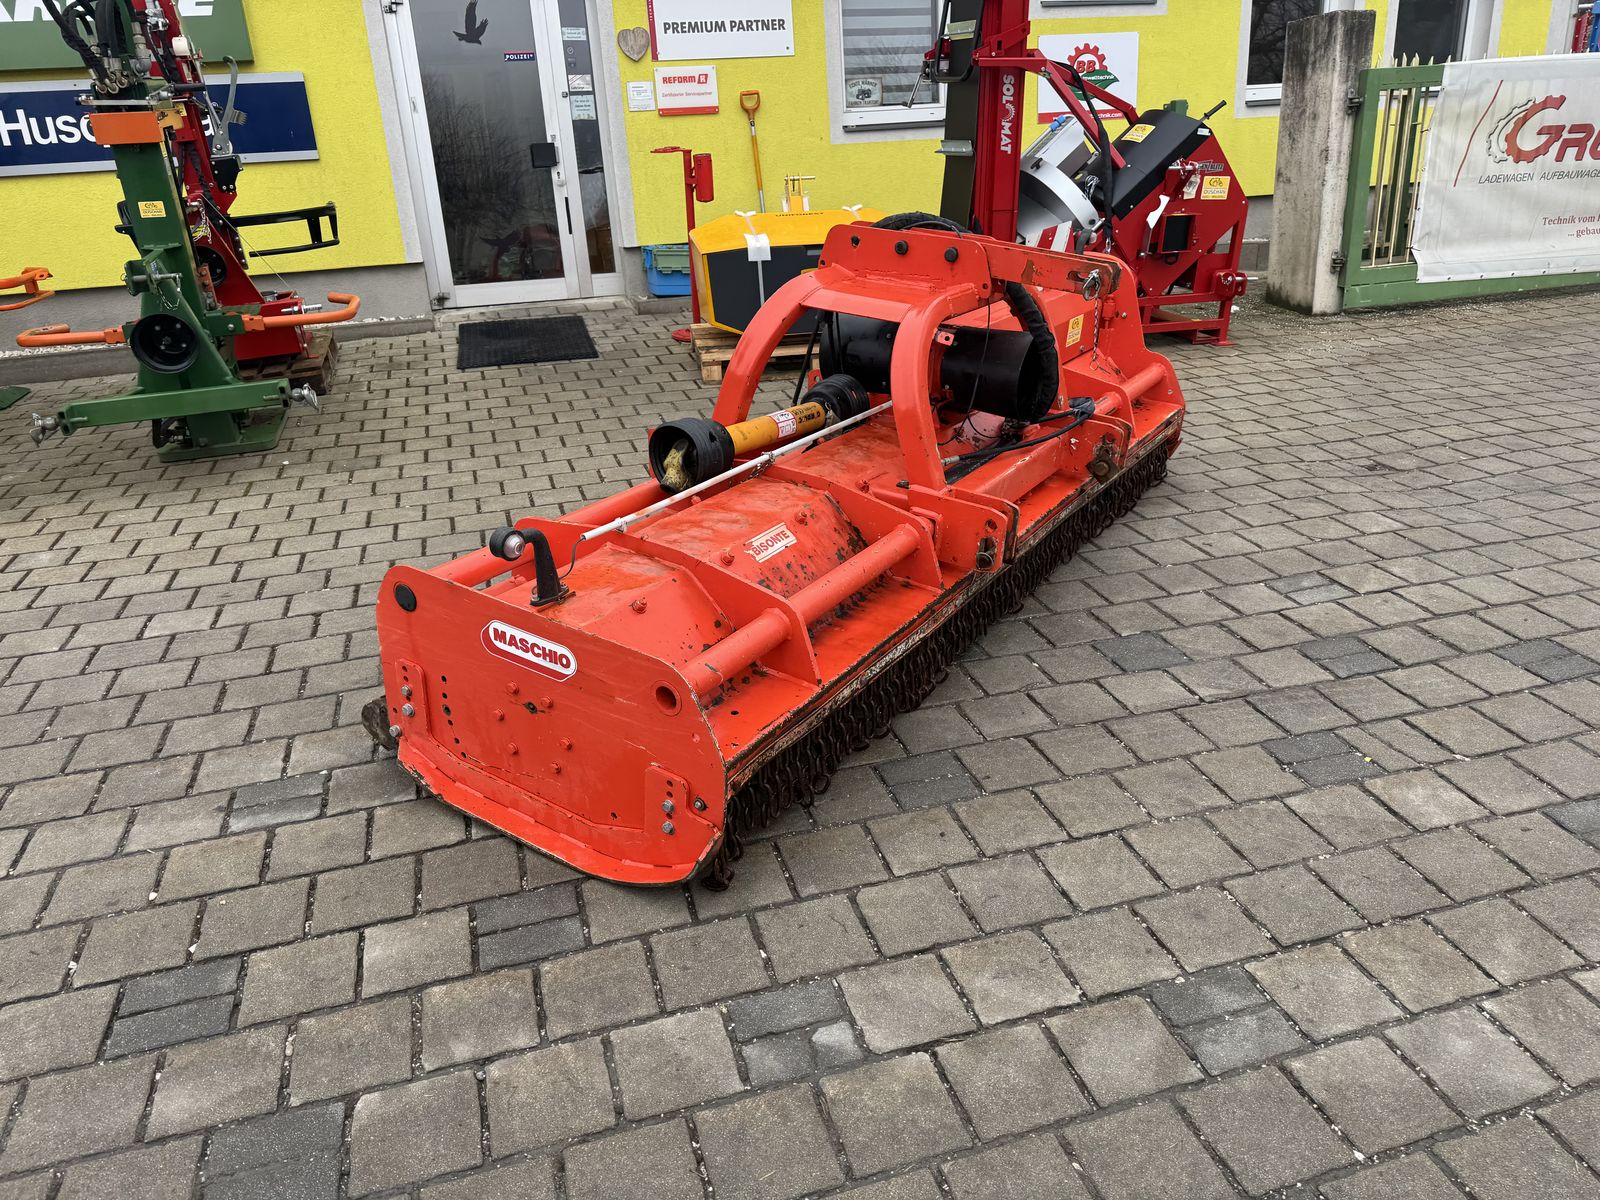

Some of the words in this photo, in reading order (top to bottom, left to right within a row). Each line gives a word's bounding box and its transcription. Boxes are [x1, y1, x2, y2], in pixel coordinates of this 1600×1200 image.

[663, 20, 727, 34] PREMIUM
[729, 18, 786, 32] PARTNER
[504, 53, 530, 61] POLIZEI
[1076, 59, 1096, 73] BB
[662, 75, 696, 85] REFORM
[1478, 172, 1535, 184] LADEWAGEN
[1542, 215, 1577, 226] Technik
[1577, 215, 1596, 223] vom
[751, 529, 791, 556] BISONTE
[492, 626, 572, 670] MASCHIO
